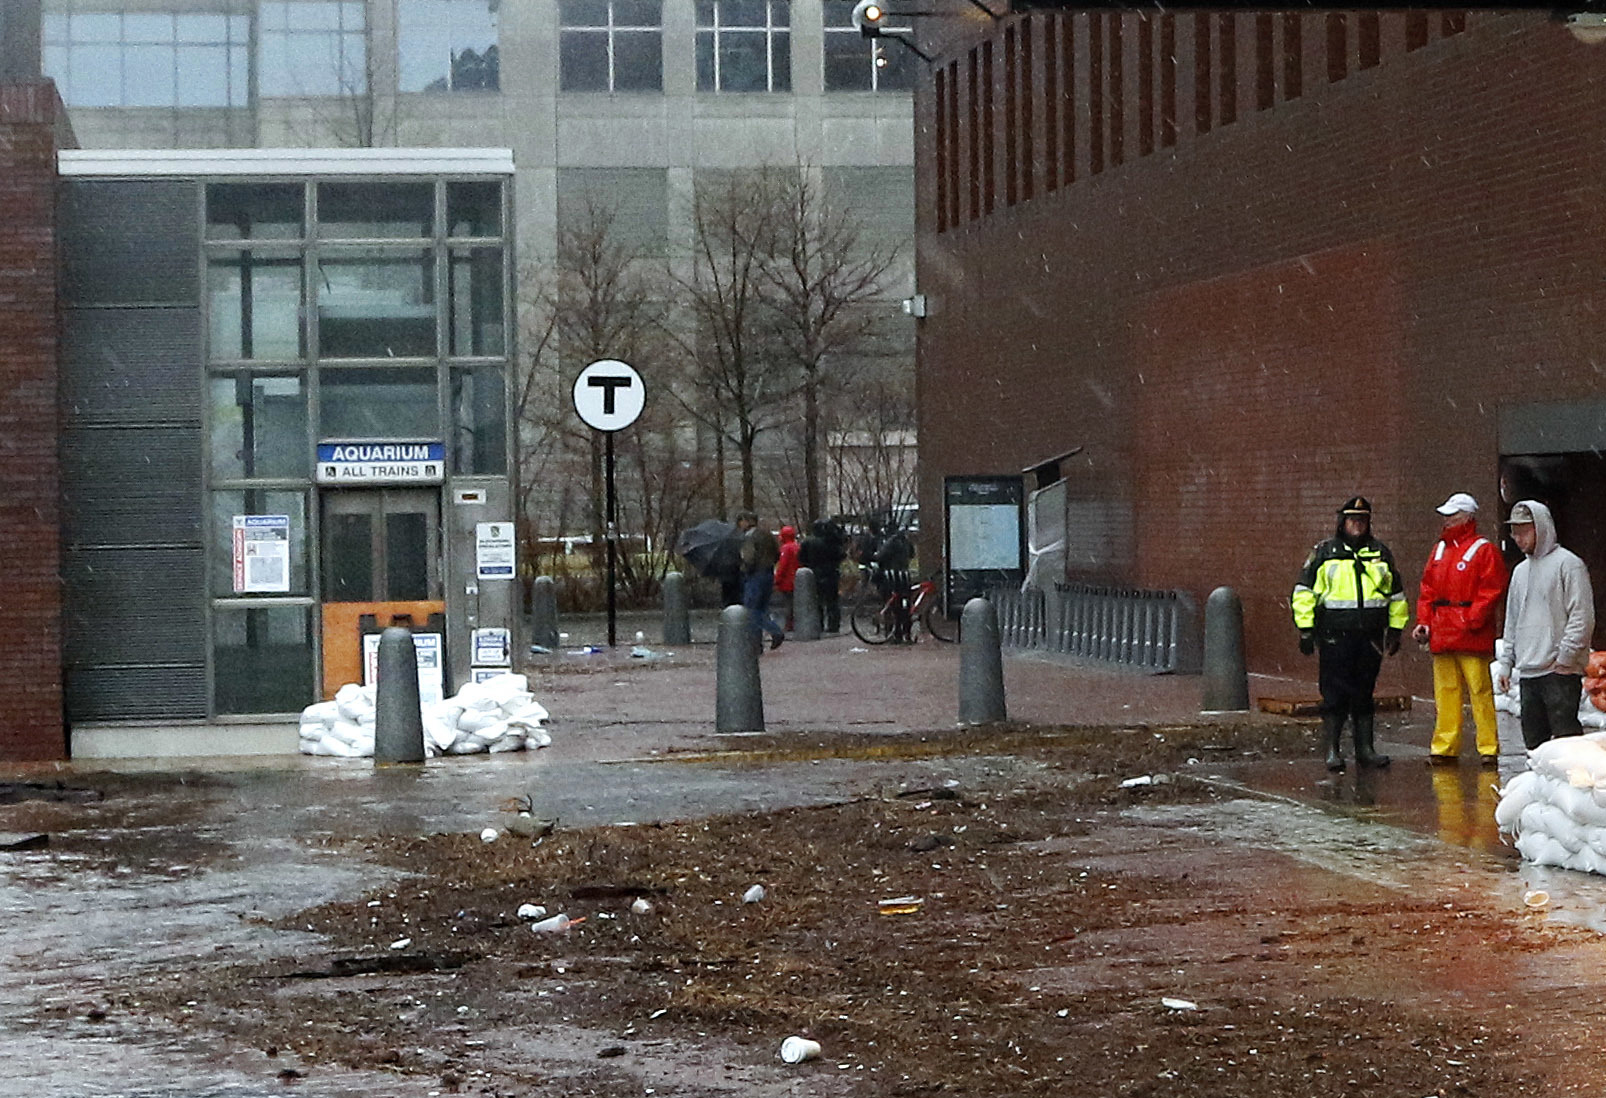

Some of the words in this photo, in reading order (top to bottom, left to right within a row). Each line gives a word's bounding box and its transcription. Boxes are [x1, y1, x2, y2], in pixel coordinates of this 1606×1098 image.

[587, 376, 632, 415] T
[332, 445, 429, 461] AQUARIUM
[342, 466, 367, 477] ALL
[371, 465, 419, 477] TRAINS
